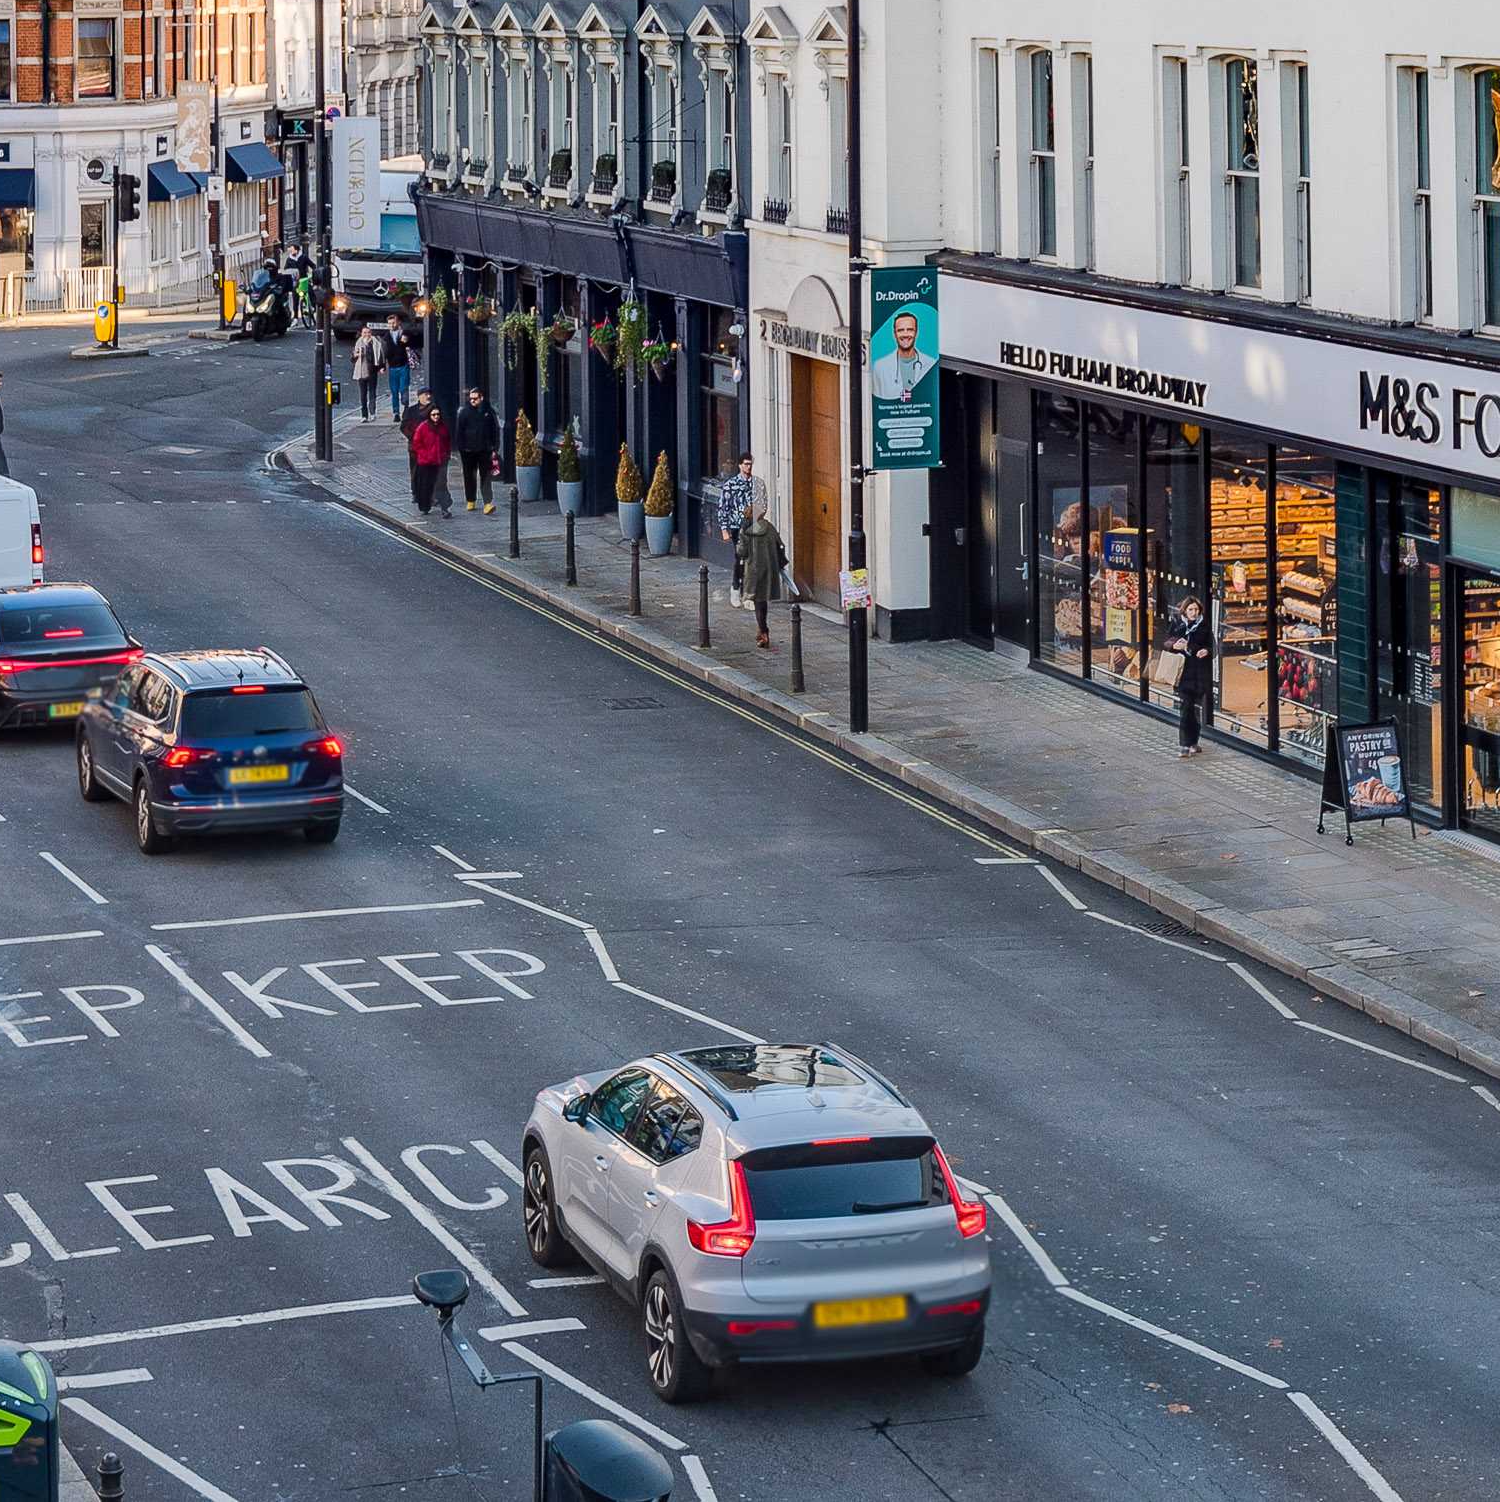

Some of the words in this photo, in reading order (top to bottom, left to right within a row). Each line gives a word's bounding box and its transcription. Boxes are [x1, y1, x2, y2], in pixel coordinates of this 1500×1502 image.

[771, 321, 820, 354] BROADWAY
[821, 334, 850, 361] HOUS
[1000, 341, 1046, 373] HELLO
[1049, 351, 1112, 388] FULHAM
[1115, 365, 1209, 408] BROADWAY
[1359, 369, 1442, 445] M&S
[1350, 740, 1382, 752] PASTRY
[222, 948, 547, 1018] KEEP
